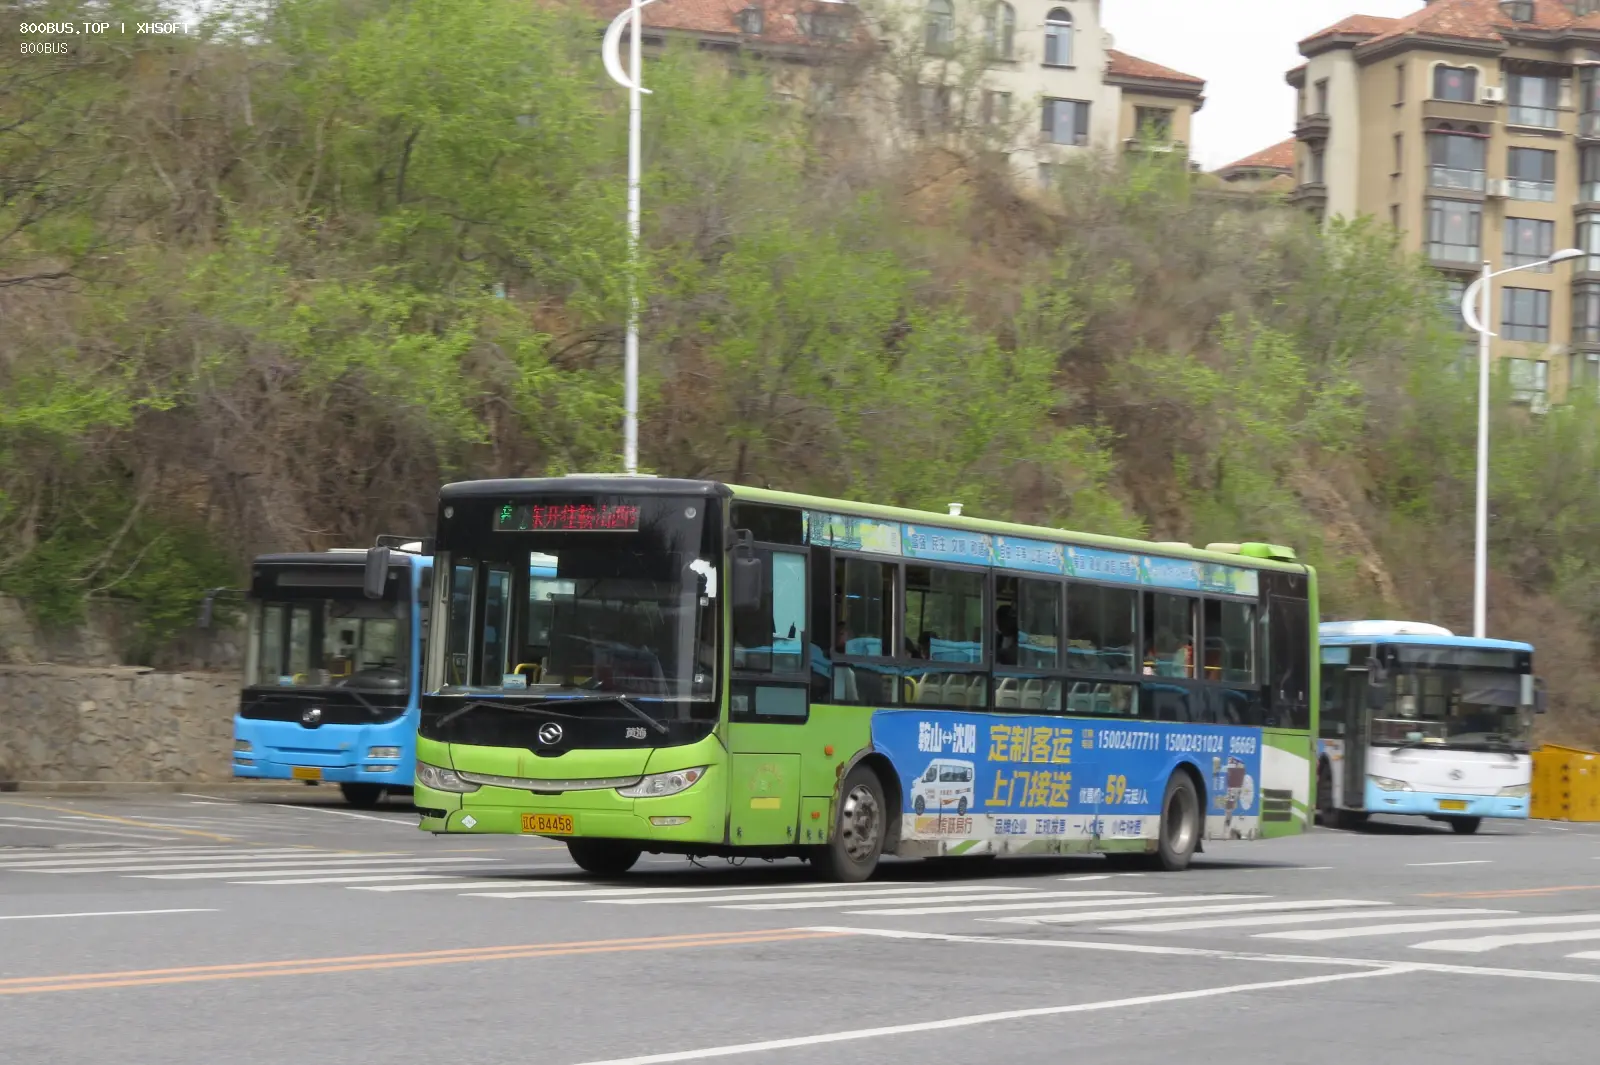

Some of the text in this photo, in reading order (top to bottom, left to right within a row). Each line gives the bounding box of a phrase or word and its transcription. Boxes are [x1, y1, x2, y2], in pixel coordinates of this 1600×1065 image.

[918, 721, 977, 754] 鞍山 沈阳
[988, 724, 1073, 764] 定制客运
[1098, 730, 1160, 751] 15002477711
[984, 769, 1072, 808] 上门接送
